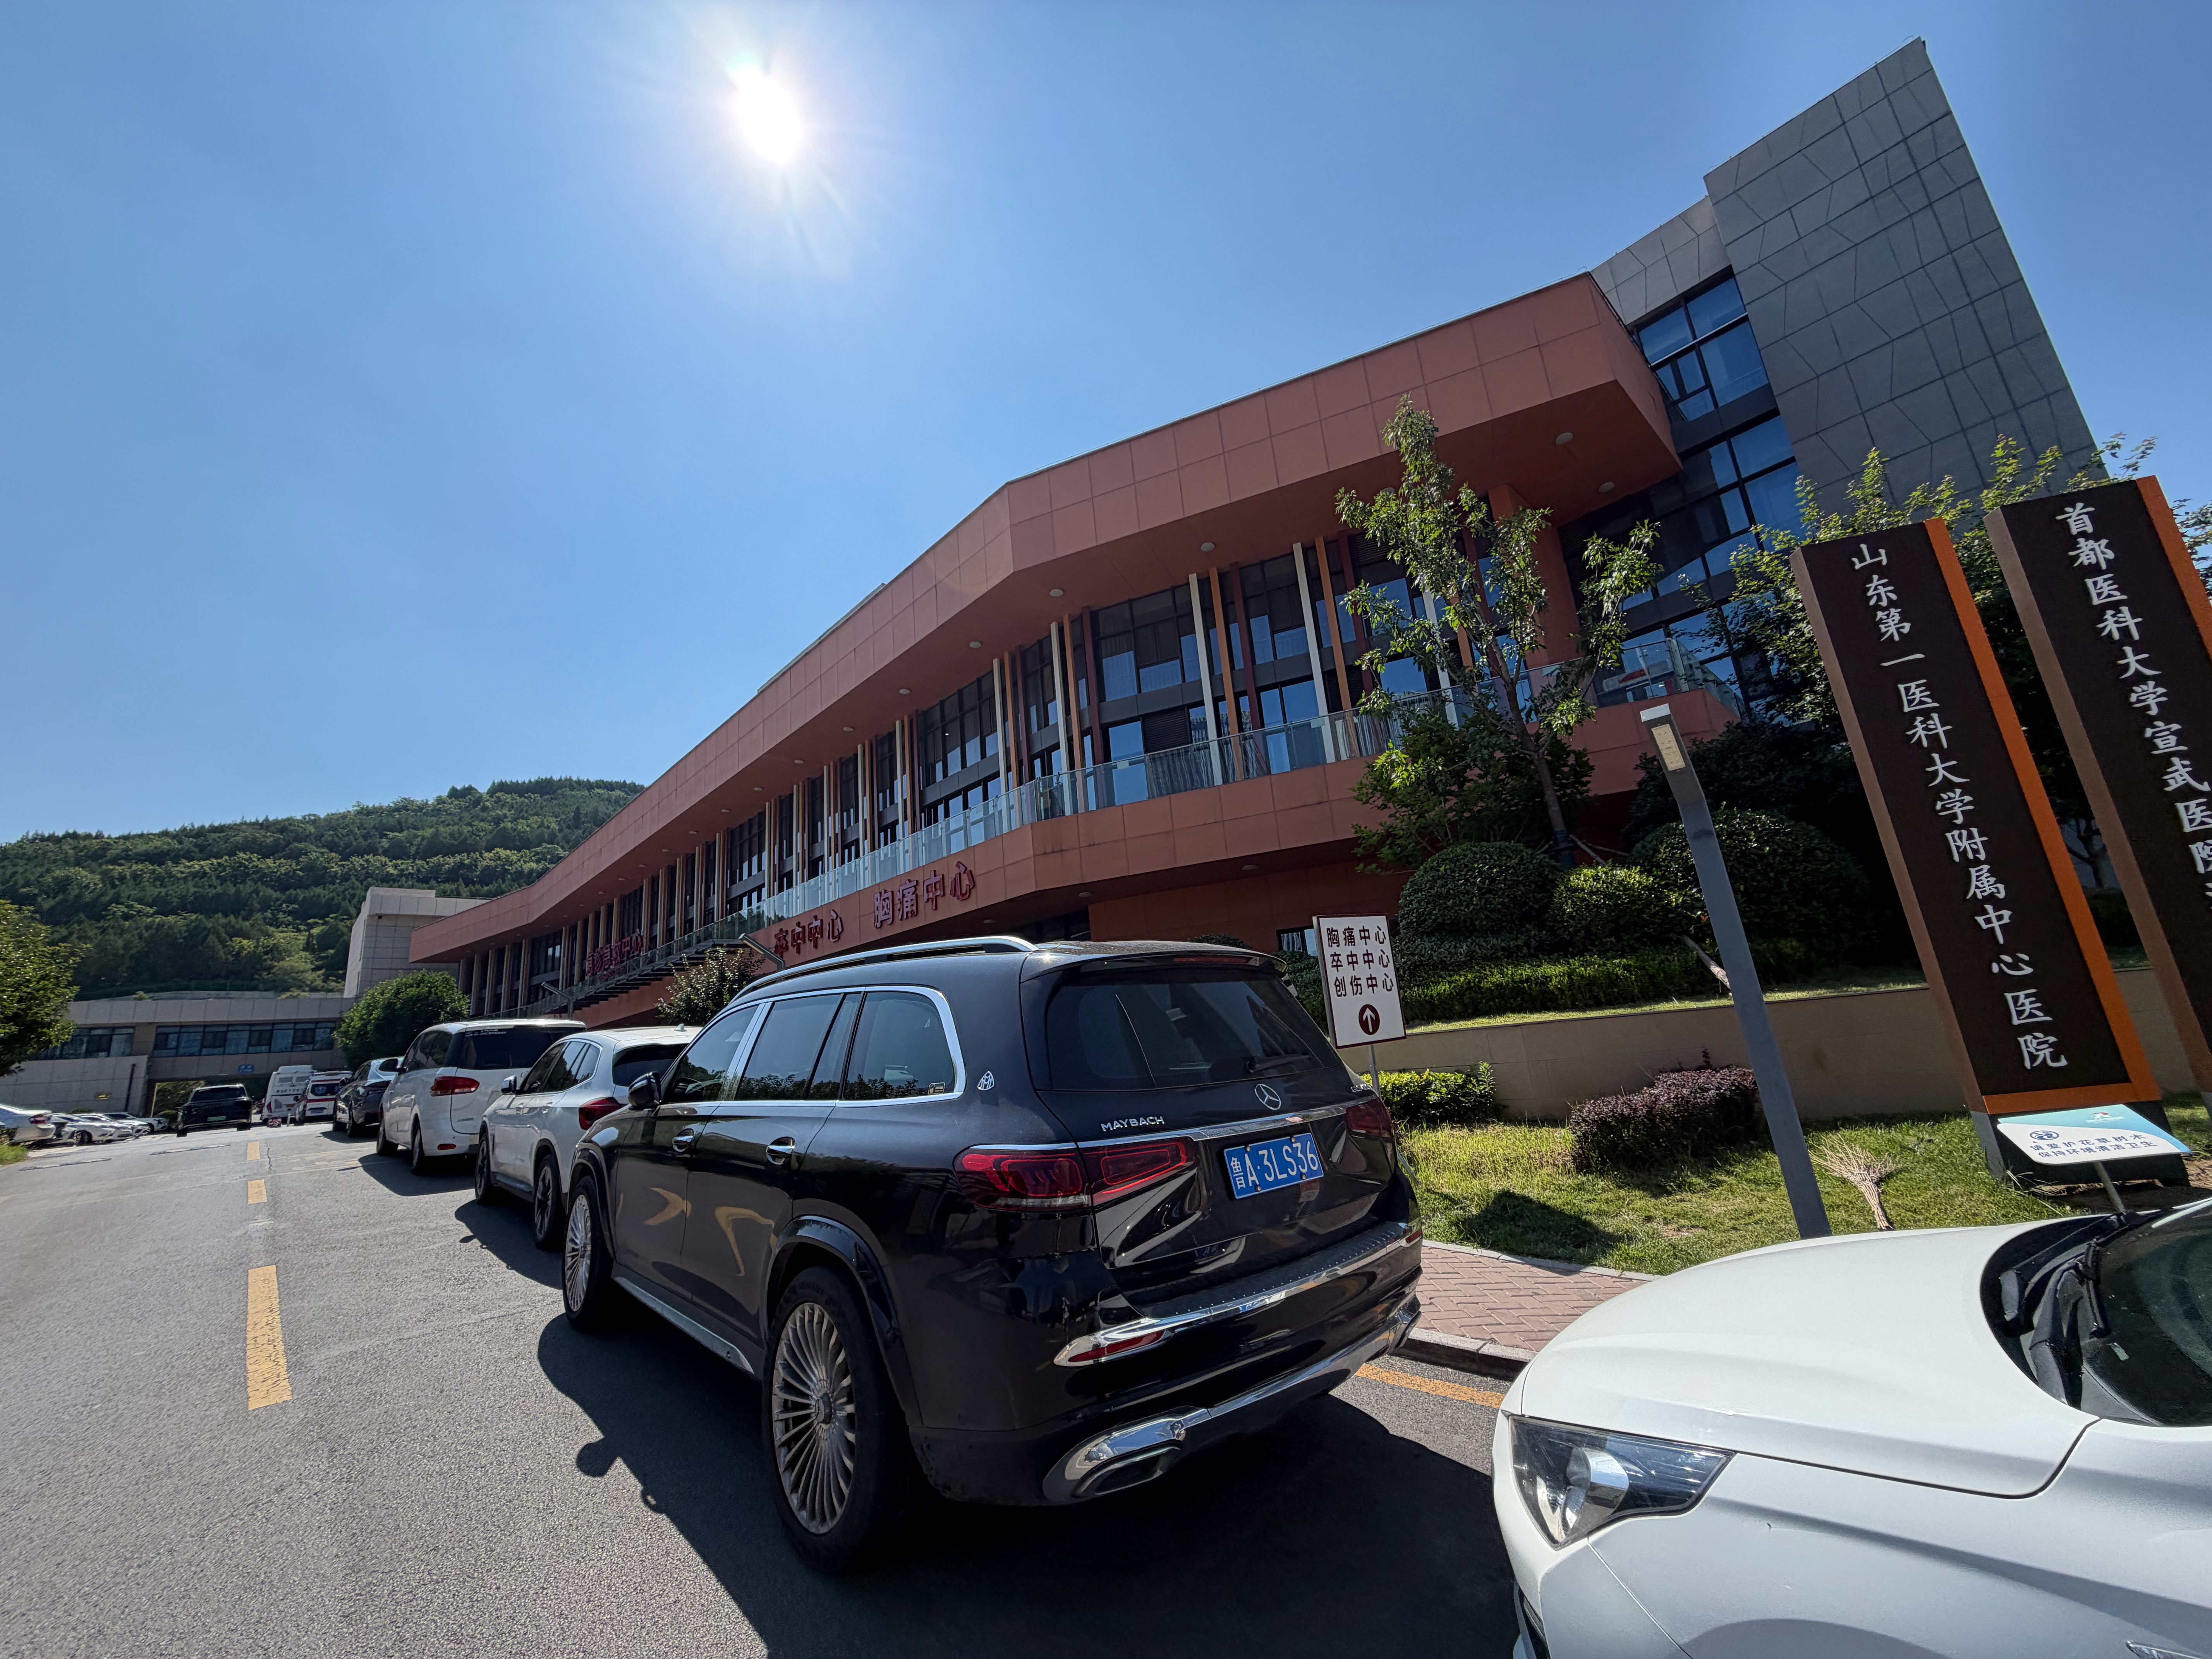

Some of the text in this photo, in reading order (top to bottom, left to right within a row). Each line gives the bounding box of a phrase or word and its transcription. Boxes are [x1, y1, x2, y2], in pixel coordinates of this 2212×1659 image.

[2056, 502, 2212, 911] 首都医科大学宣武医院
[1851, 544, 2068, 1069] 山东第一医科大学附属中心医院
[874, 861, 975, 929] 胸痛中心
[774, 909, 844, 959] 卒中中心
[1326, 926, 1386, 948] 胸痛中心
[1330, 949, 1390, 972] 卒中中心
[1334, 972, 1394, 997] 创伤中心
[1101, 1116, 1165, 1132] MAYBACH
[2030, 1134, 2147, 1151] 请爱护花草树木
[2039, 1141, 2158, 1158] 保持环境清洁卫生
